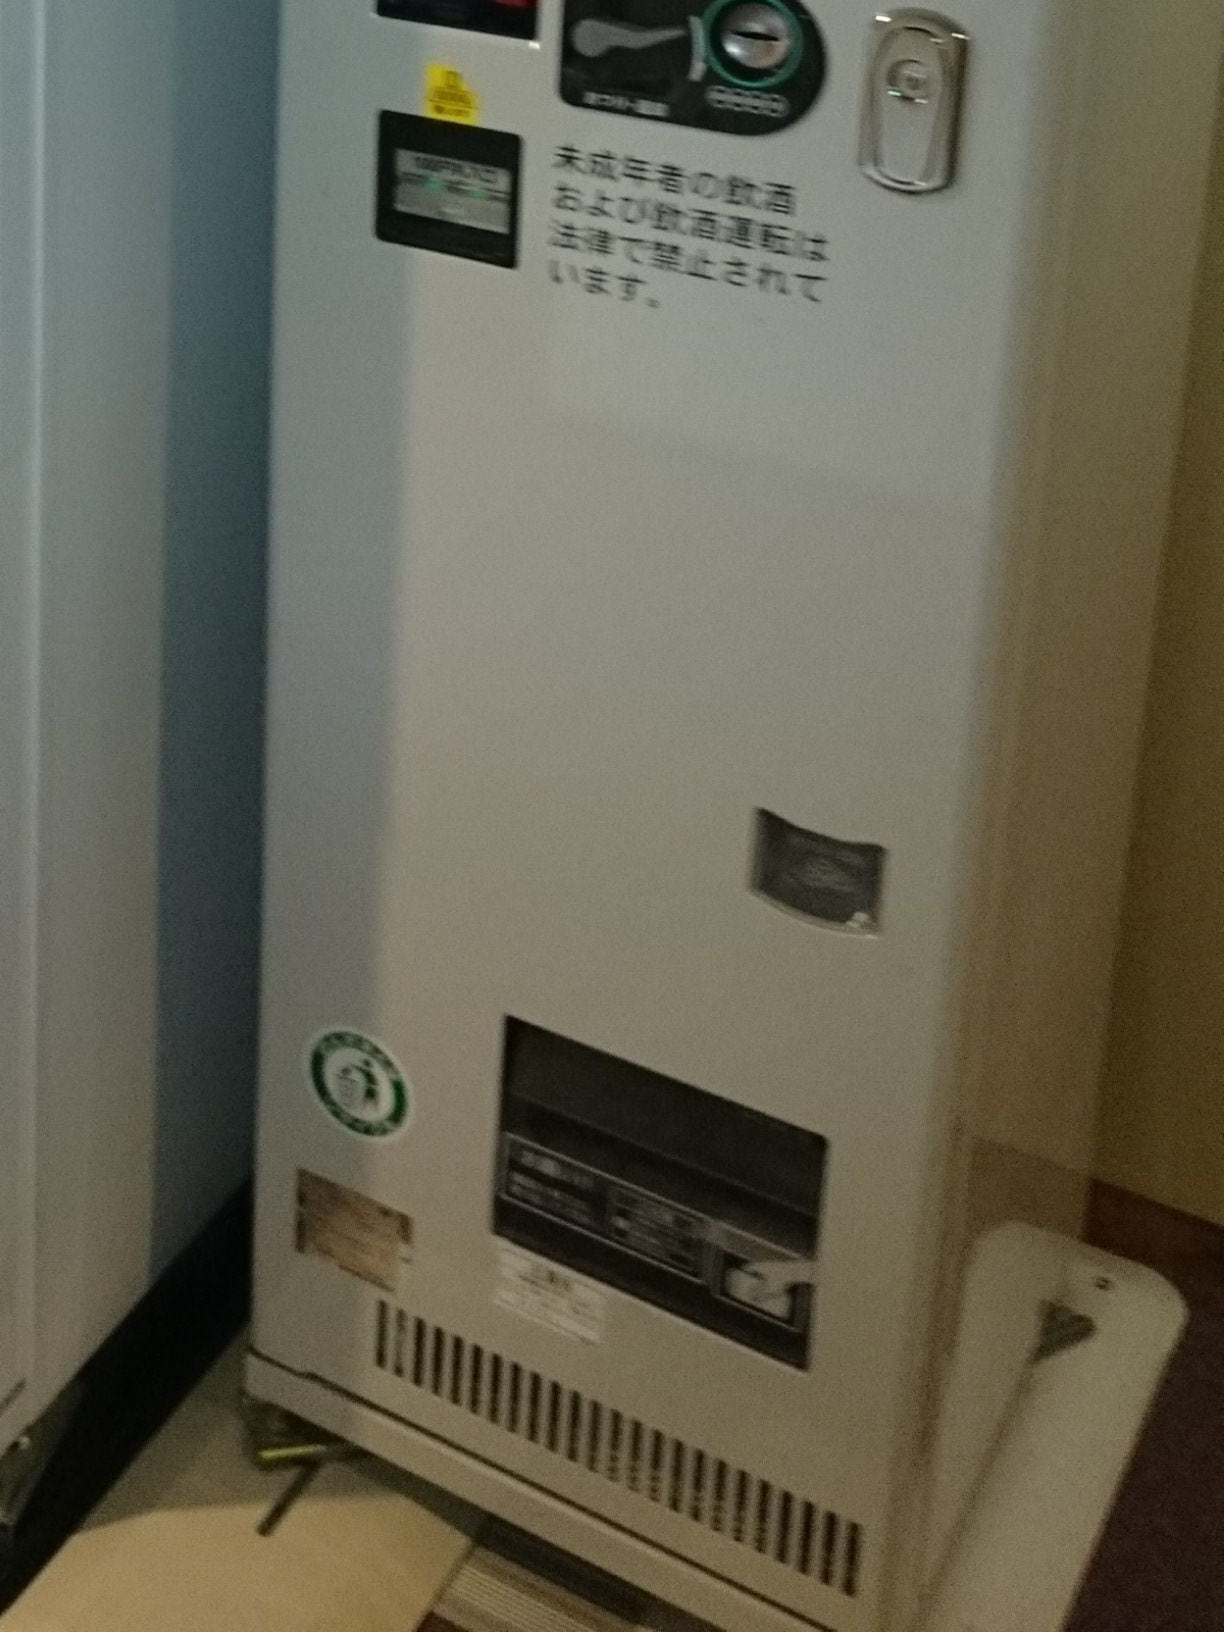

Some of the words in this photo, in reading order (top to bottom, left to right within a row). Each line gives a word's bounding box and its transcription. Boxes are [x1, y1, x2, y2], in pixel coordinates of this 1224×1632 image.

[552, 144, 797, 215] 未成年者の飲酒
[549, 218, 828, 303] 法律で禁止されて
[552, 183, 830, 262] および飲酒運転は
